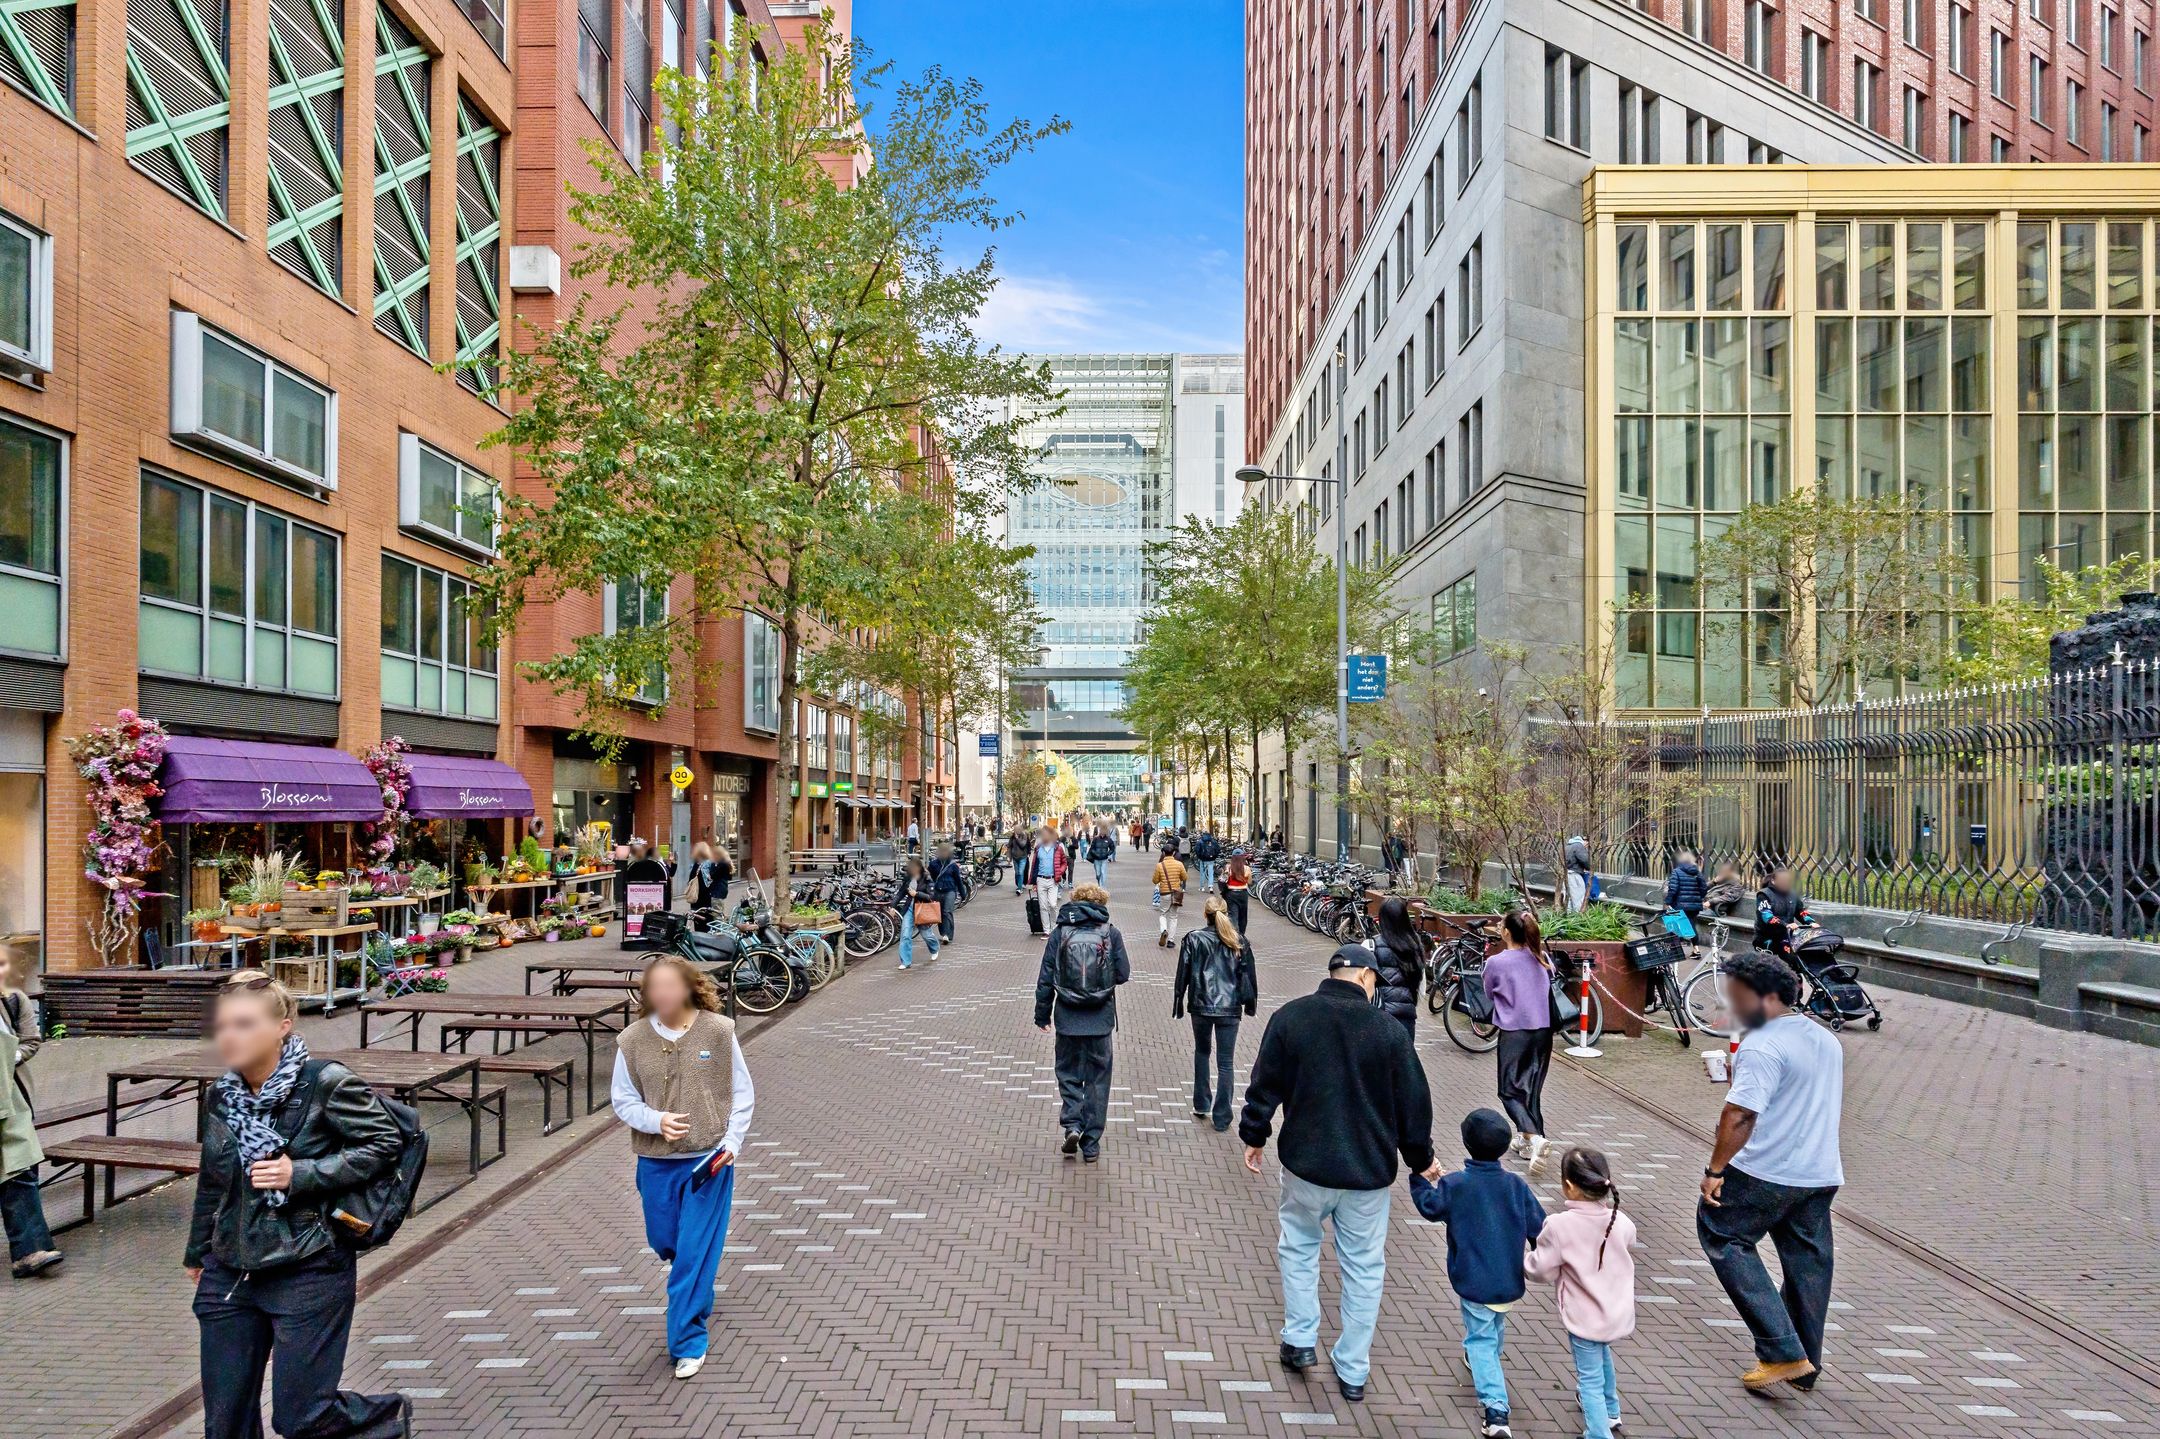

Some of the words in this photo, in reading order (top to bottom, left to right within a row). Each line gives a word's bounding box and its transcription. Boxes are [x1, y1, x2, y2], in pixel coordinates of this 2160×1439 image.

[713, 774, 750, 792] NTOREN
[261, 783, 328, 808] Blossom
[460, 789, 502, 809] Blossom
